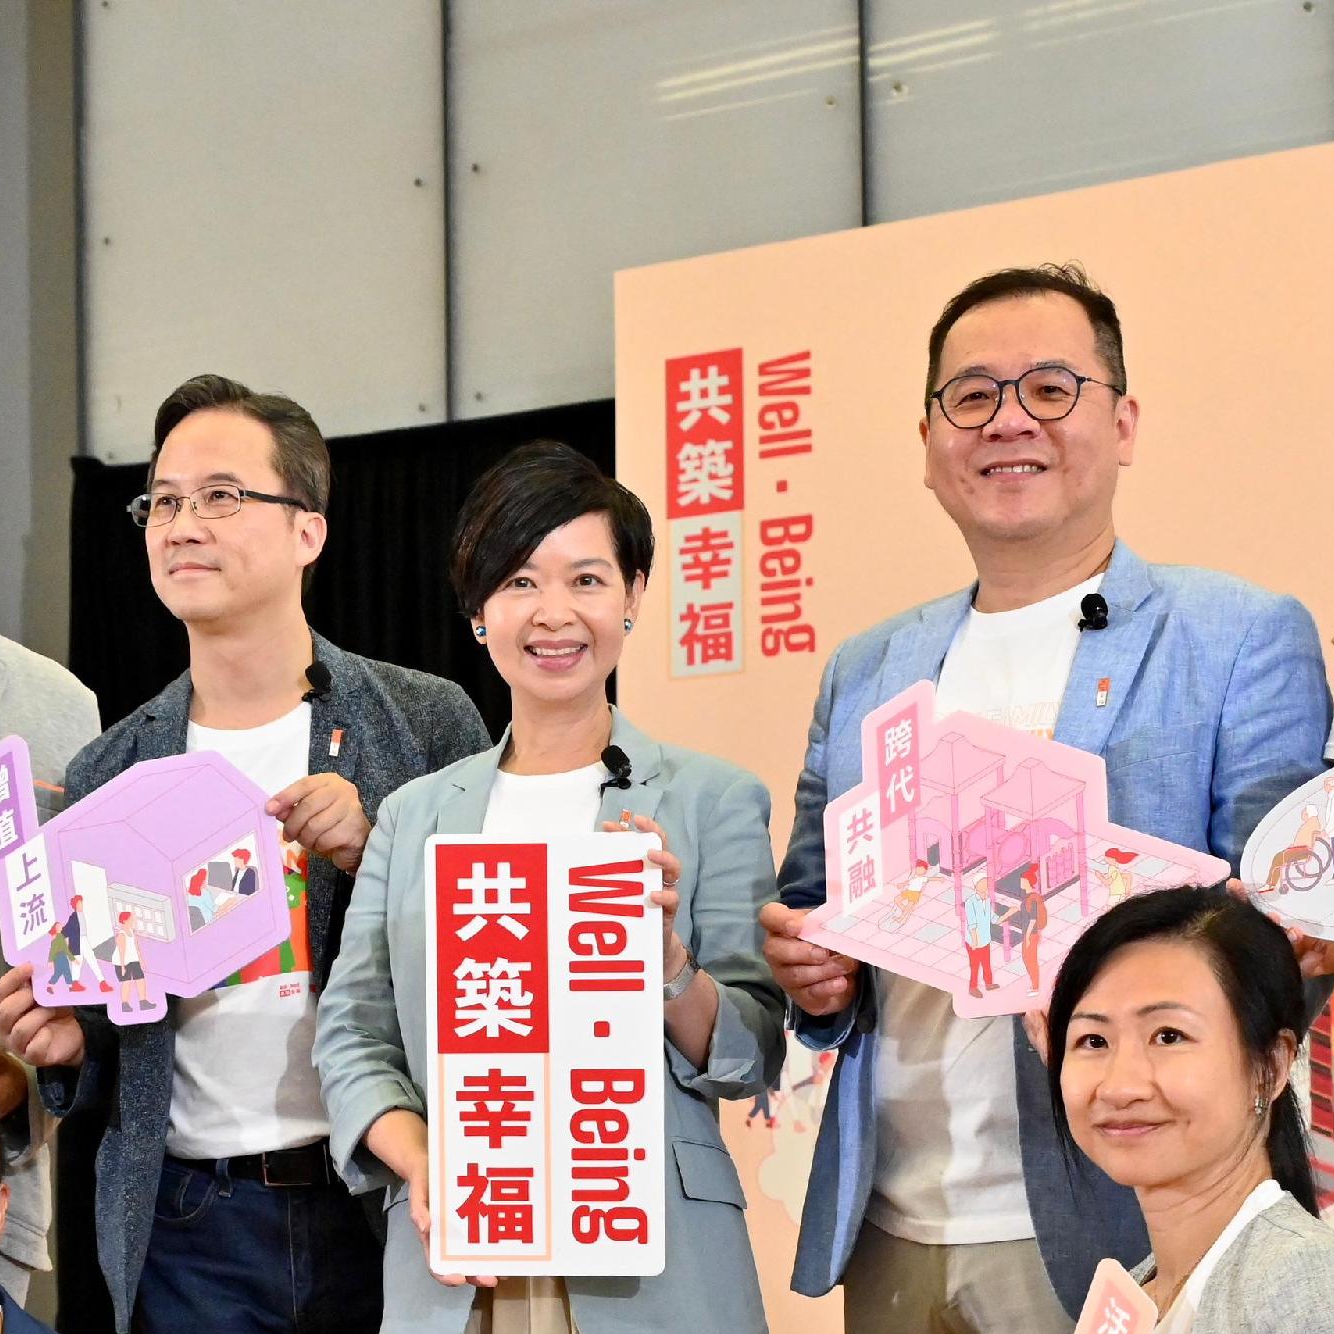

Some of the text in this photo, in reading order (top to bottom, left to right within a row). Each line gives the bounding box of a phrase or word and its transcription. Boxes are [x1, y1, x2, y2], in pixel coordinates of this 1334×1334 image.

[757, 350, 813, 459] Well
[675, 366, 735, 667] 共築幸福
[759, 513, 816, 658] Being
[883, 717, 916, 812] 跨代
[15, 851, 49, 938] 上流
[846, 808, 875, 903] 共融
[568, 859, 645, 992] Well
[452, 860, 534, 1245] 共築幸福
[569, 1068, 648, 1246] Being
